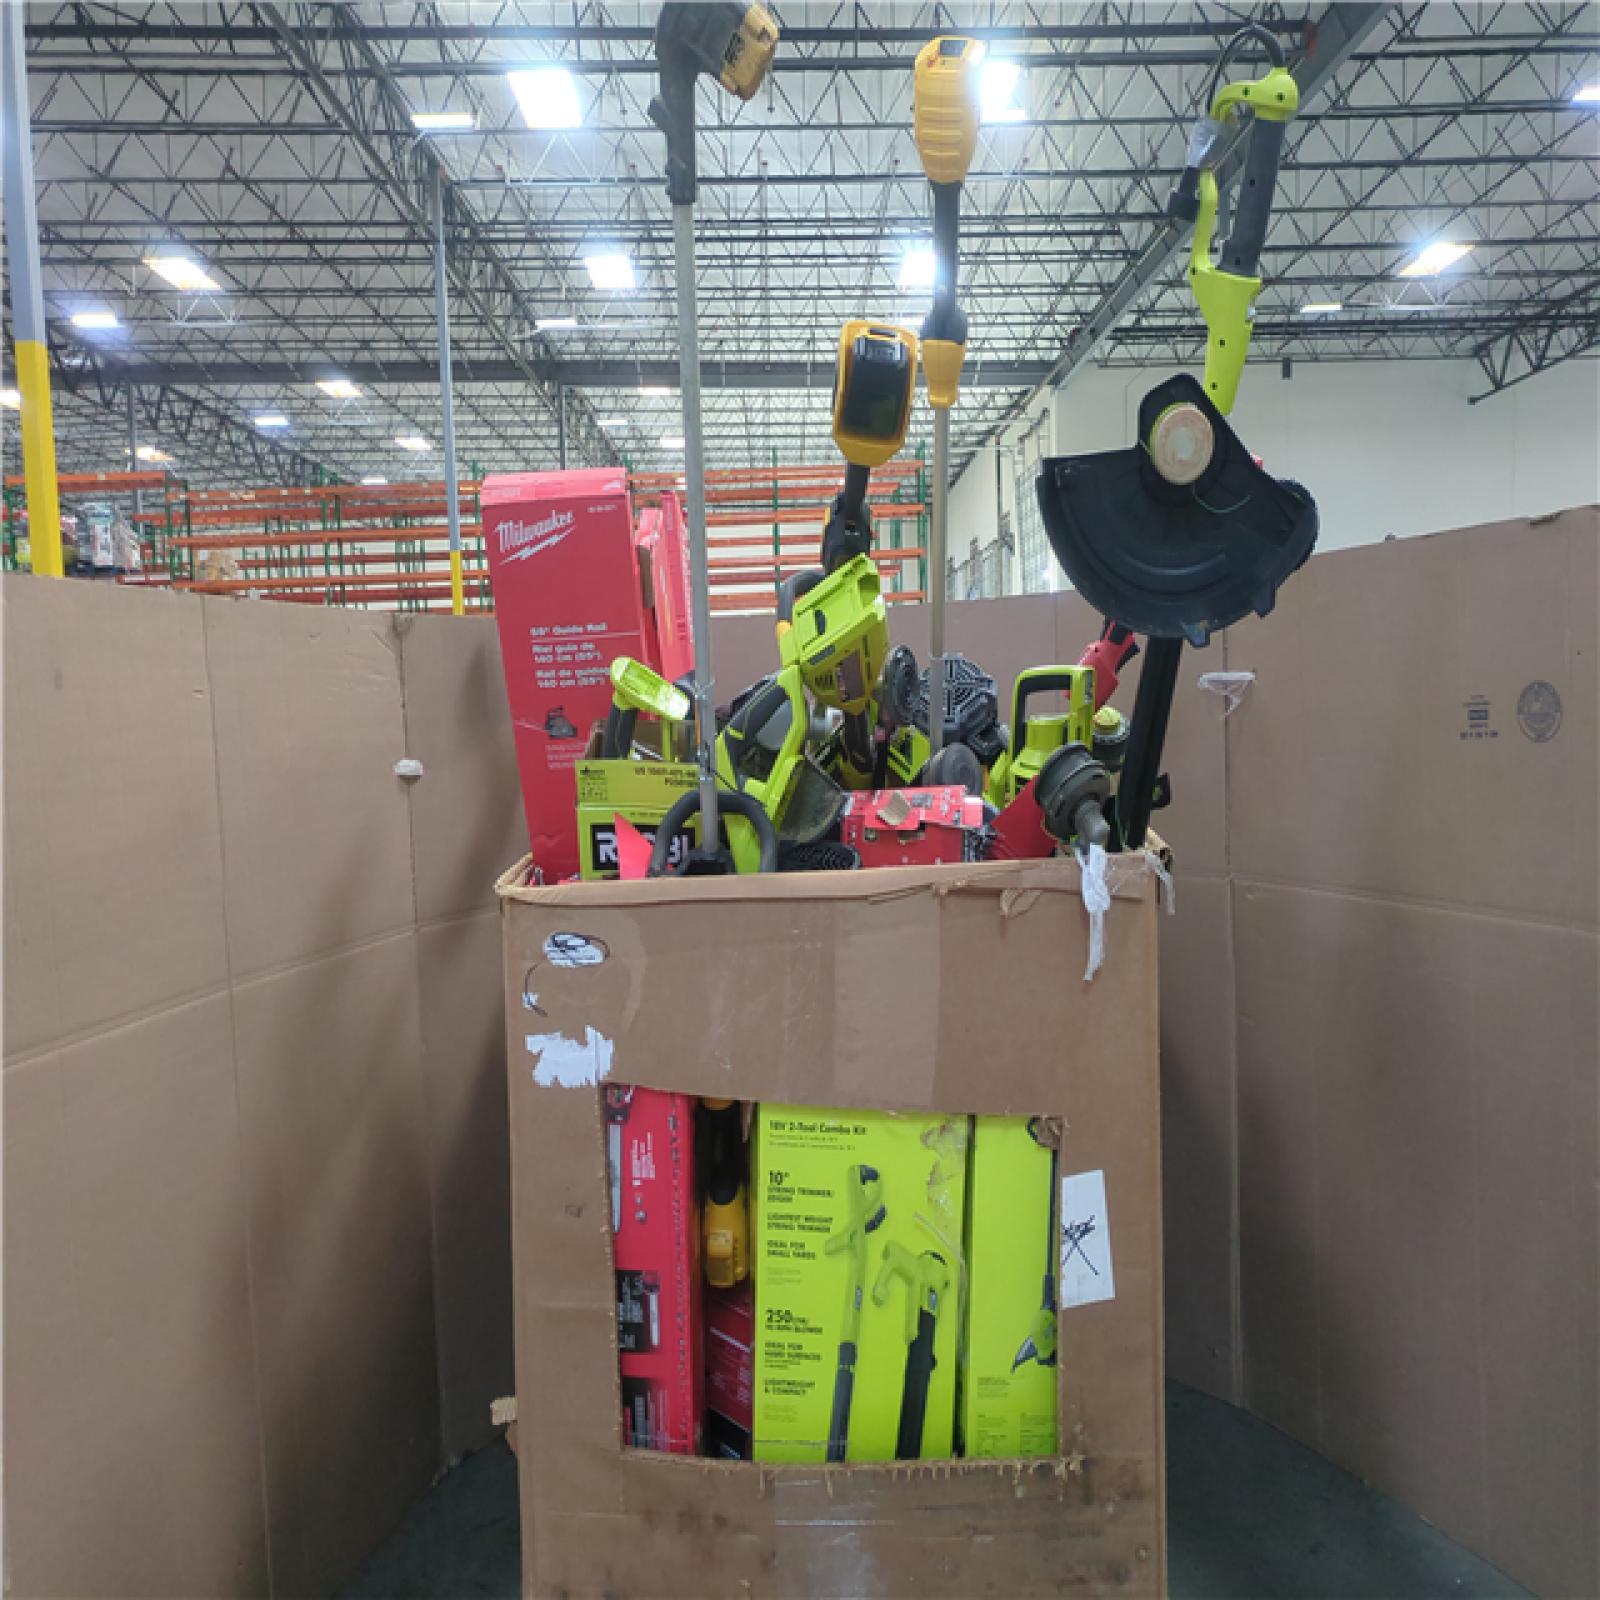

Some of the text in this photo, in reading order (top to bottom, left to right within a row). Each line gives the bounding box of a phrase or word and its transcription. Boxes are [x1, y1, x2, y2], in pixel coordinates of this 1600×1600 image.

[494, 509, 574, 552] Milwaukee
[819, 1122, 850, 1135] Combo
[854, 1125, 866, 1135] Kit
[766, 1309, 793, 1323] 250
